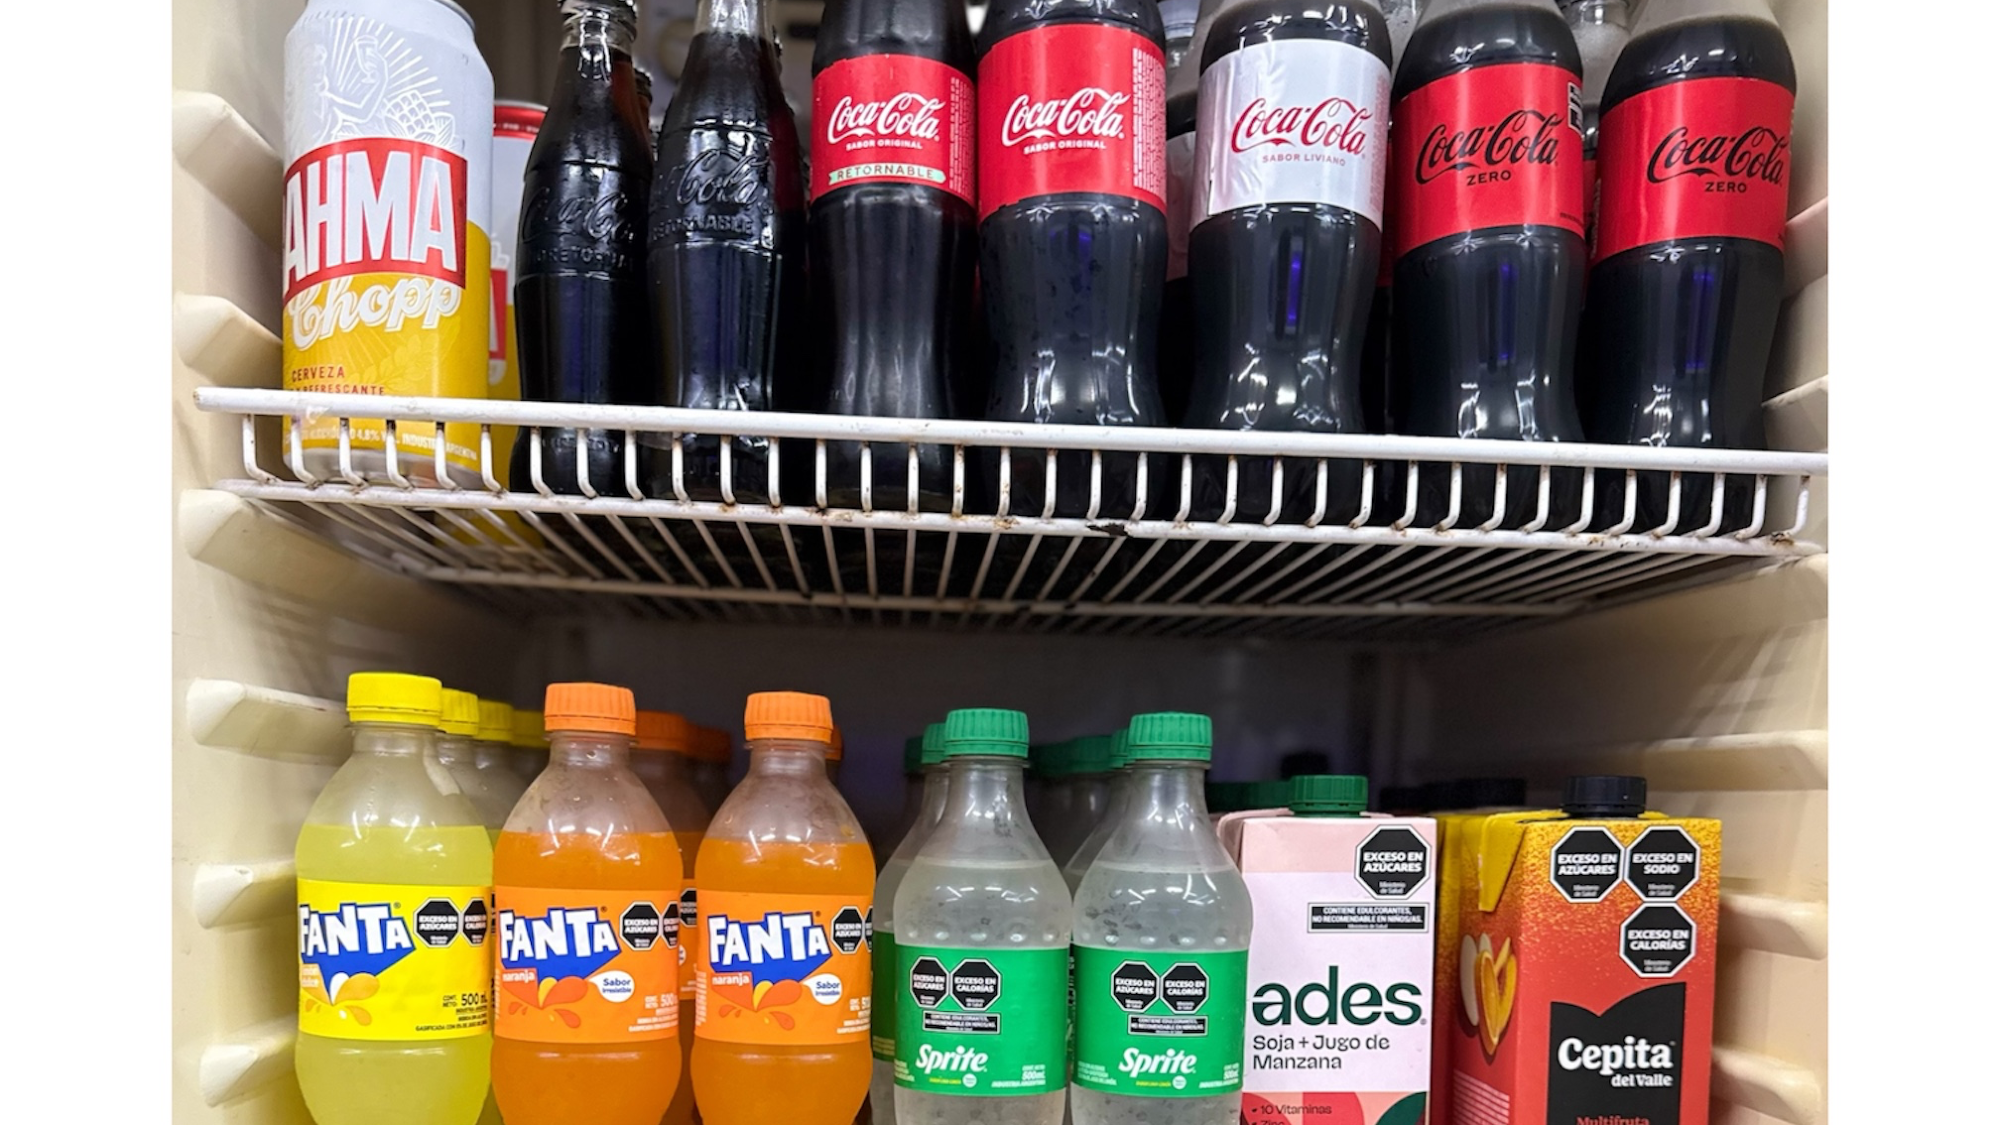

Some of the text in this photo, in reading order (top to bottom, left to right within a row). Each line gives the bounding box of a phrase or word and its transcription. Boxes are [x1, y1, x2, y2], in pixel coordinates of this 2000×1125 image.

[827, 92, 946, 144] Coca-Cola
[1001, 87, 1131, 147] Coca-Cola
[1230, 97, 1373, 155] Coca-Cola
[846, 139, 923, 151] SABOR ORIGINAL
[1023, 140, 1107, 155] SABOR ORIGINAL
[1415, 109, 1565, 185] Coca-Cola
[1262, 153, 1346, 167] SABOR LIVIANO
[1646, 126, 1789, 185] Coca-Cola
[837, 165, 935, 180] RETORNABLE
[1466, 170, 1511, 186] ZERO
[1704, 181, 1747, 193] ZERO
[287, 274, 462, 351] Chopp
[292, 366, 345, 382] CERVEZA
[1363, 852, 1424, 862] EXCESO EN
[1558, 853, 1618, 864] EXCESO EN
[1632, 853, 1693, 864] EXCESO EN
[1363, 860, 1422, 873] AZÚCARES
[1558, 863, 1616, 876] AZÚCARES
[1643, 863, 1680, 875] SODIO
[1323, 907, 1356, 915] CONTIENE
[1313, 915, 1323, 923] NO
[1323, 915, 1376, 923] RECOMENDABLE
[1377, 915, 1387, 923] EN
[299, 903, 413, 957] FANTA
[499, 909, 619, 962] FANTA
[1628, 929, 1689, 940] EXCESO EN
[708, 913, 830, 966] FANTA
[1629, 938, 1686, 951] CALORÍAS
[502, 969, 535, 983] naranja
[603, 977, 632, 987] Sabor
[712, 973, 750, 986] naranja
[954, 976, 997, 985] EXCESO EN
[1115, 978, 1155, 988] EXCESO EN
[815, 981, 840, 990] Sabor
[956, 984, 995, 993] CALORÍAS
[1164, 980, 1206, 988] EXCESO EN
[461, 993, 479, 1006] 500
[1252, 965, 1422, 1026] ades
[1253, 1034, 1295, 1052] Soja
[1312, 1035, 1361, 1052] Jugo
[1365, 1034, 1390, 1050] de
[915, 1043, 988, 1075] Sprite
[1118, 1047, 1198, 1078] Sprite
[1253, 1054, 1342, 1070] Manzana
[1557, 1035, 1674, 1076] Cepita
[1611, 1074, 1673, 1088] del Valle
[1260, 1104, 1332, 1115] 10 Vitaminas
